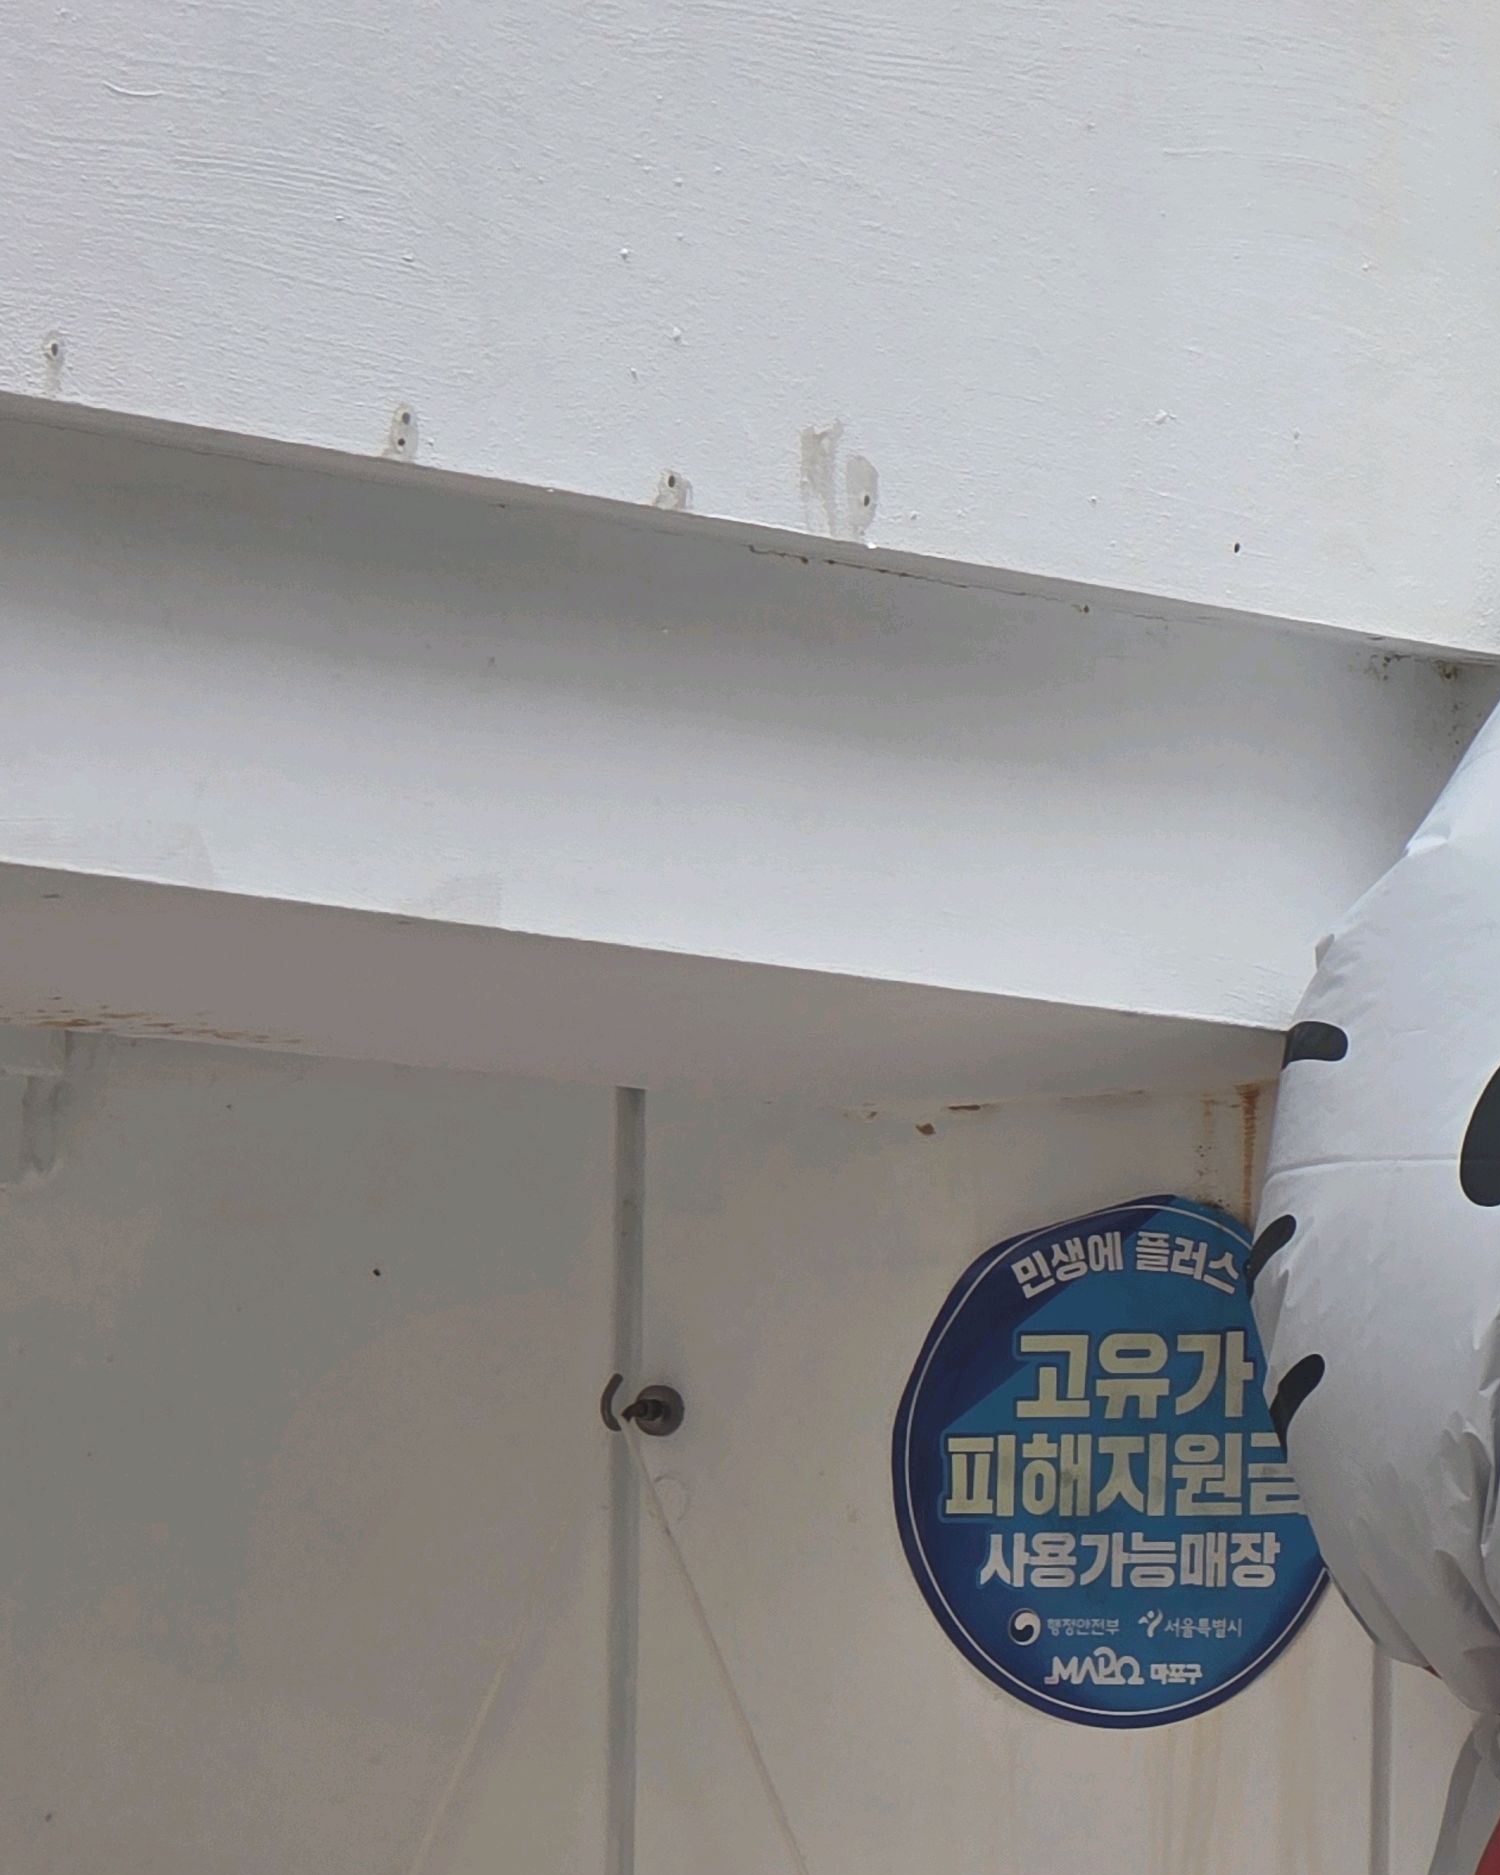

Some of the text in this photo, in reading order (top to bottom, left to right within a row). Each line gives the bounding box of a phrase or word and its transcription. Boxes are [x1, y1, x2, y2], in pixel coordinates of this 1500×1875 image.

[1011, 1231, 1239, 1299] 민생에 플러스
[1016, 1331, 1254, 1419] 고유가
[980, 1532, 1280, 1587] 사용가능매장
[1047, 1618, 1120, 1636] 행정안전부
[1164, 1617, 1243, 1639] 서울특별시
[1150, 1663, 1203, 1685] 마포구
